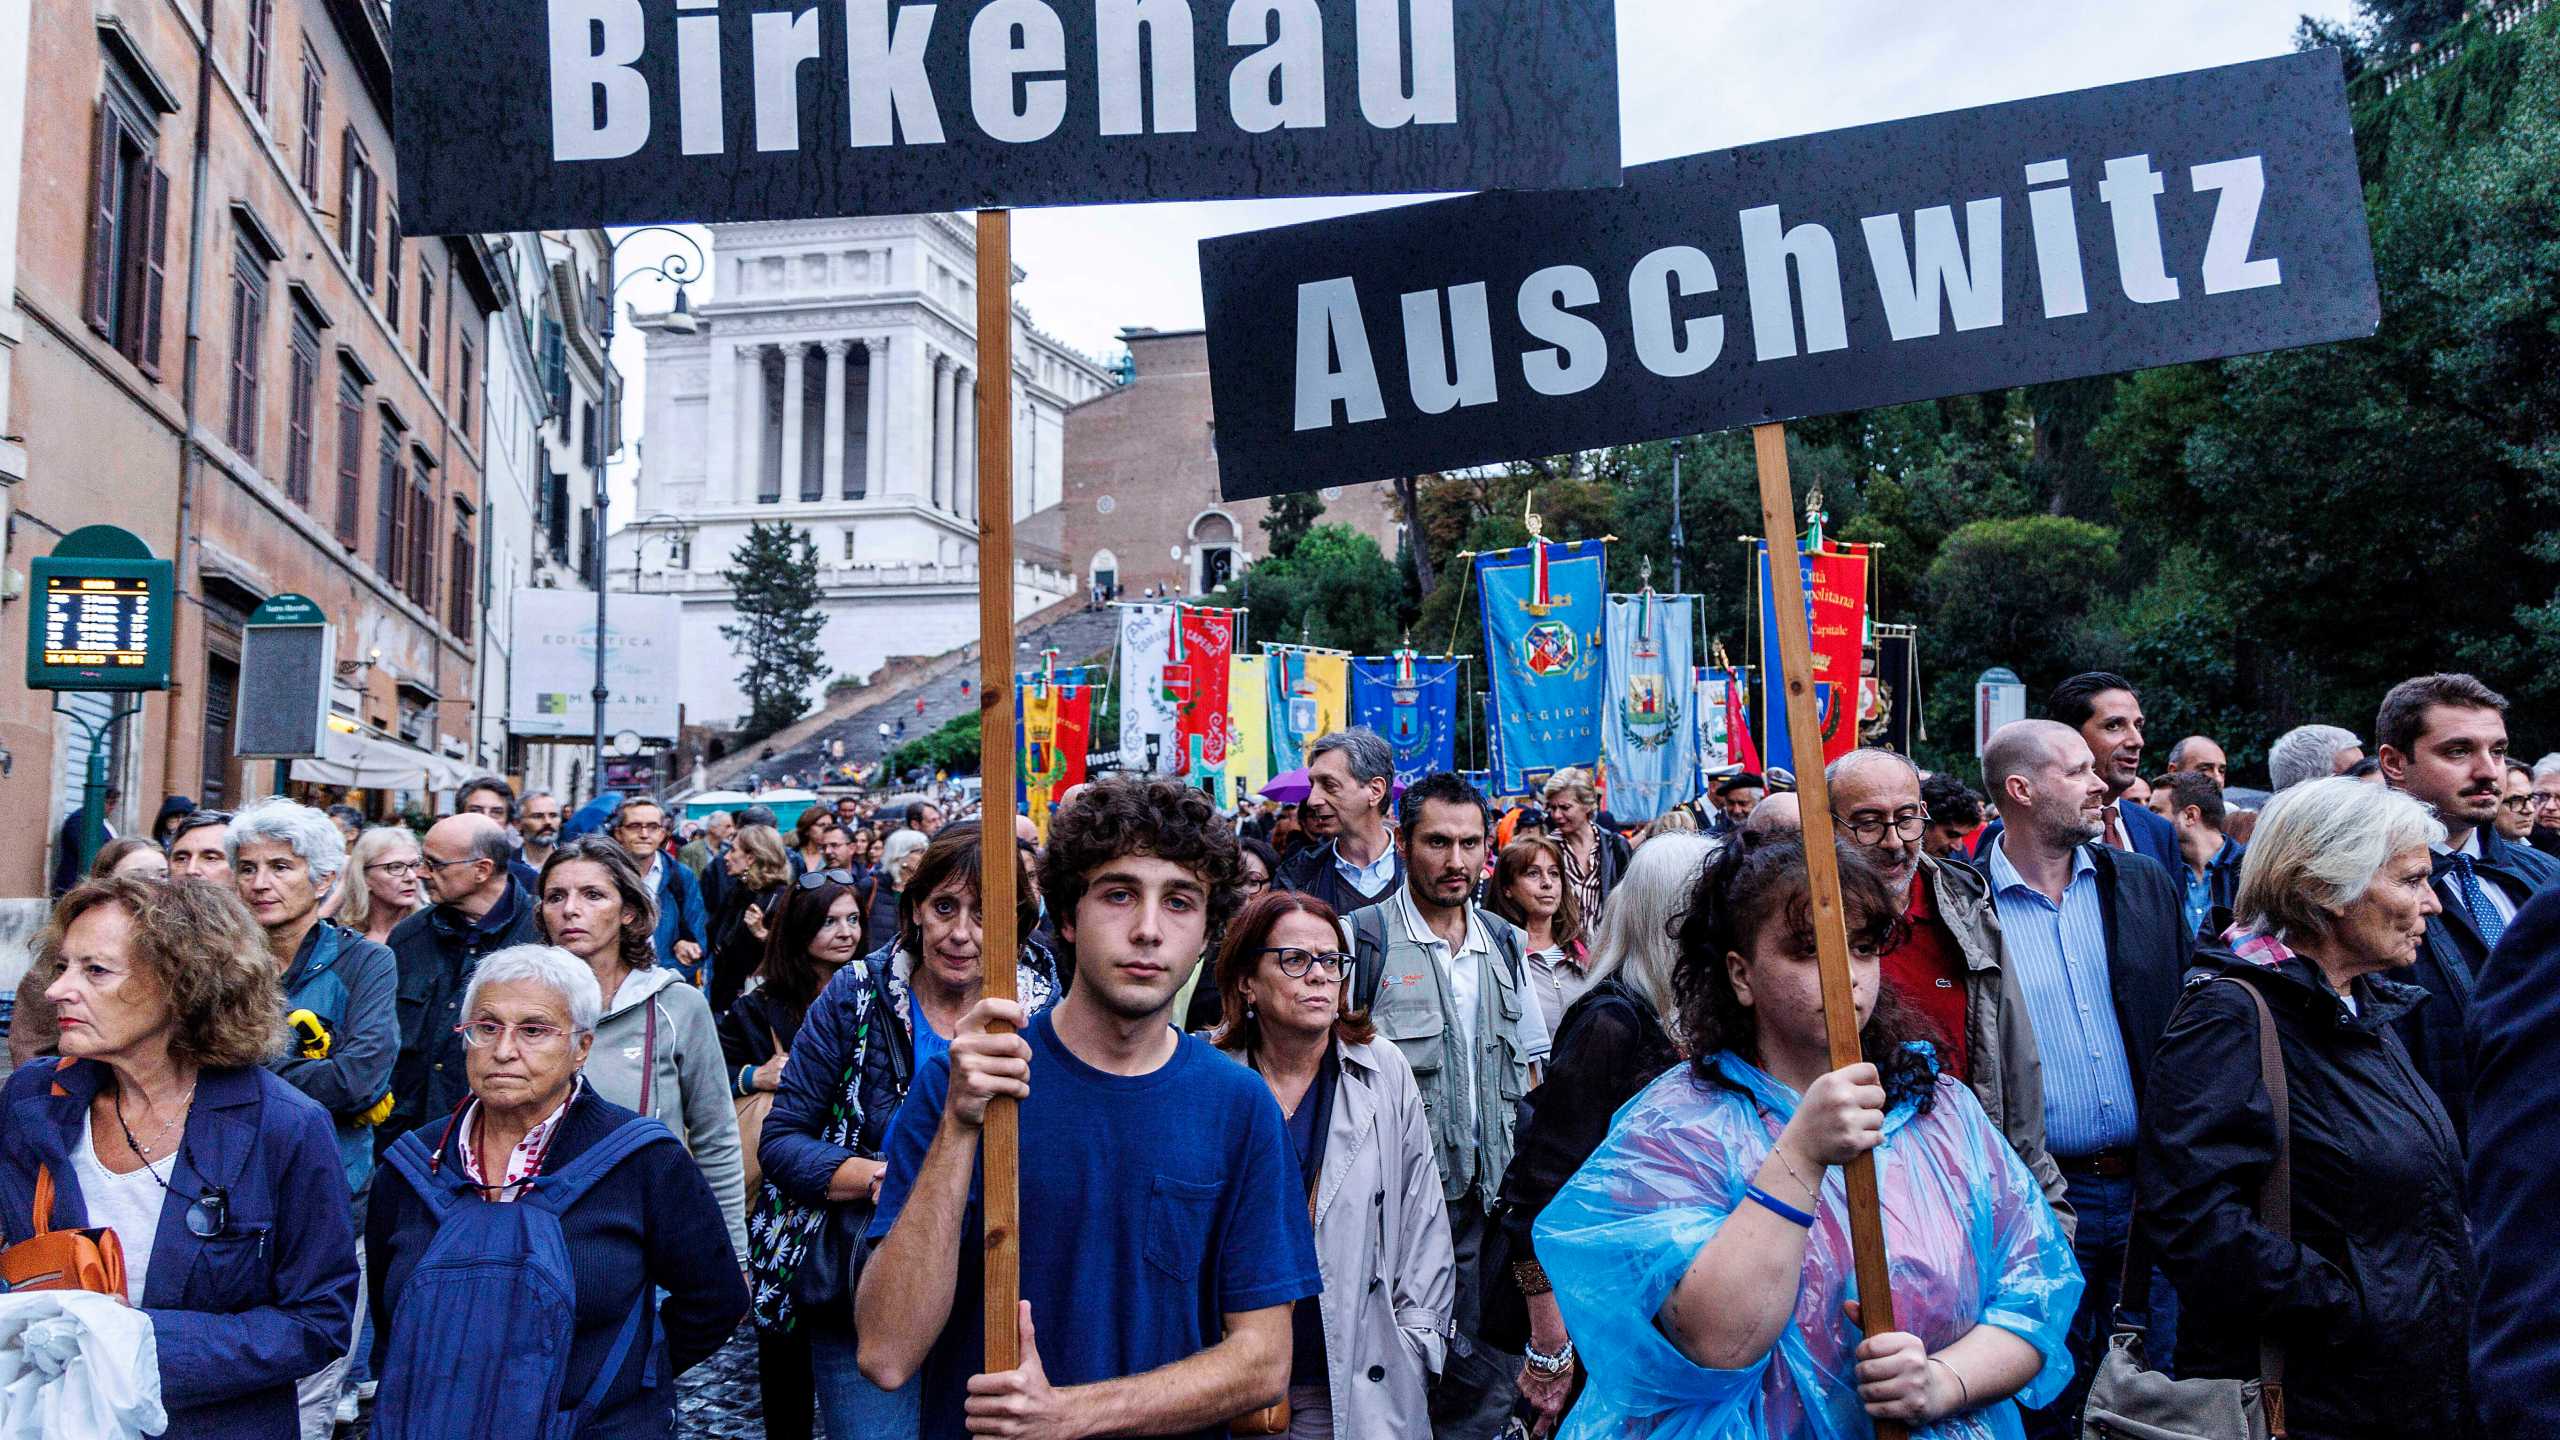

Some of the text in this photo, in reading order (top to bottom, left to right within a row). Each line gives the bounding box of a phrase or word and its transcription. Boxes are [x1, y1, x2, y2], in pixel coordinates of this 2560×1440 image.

[548, 0, 1458, 162] Birkenau
[1293, 154, 2282, 432] Auschwitz
[1803, 587, 1855, 609] opolitana
[1811, 623, 1849, 638] Capitale
[542, 634, 652, 647] EDILTICA
[1136, 628, 1169, 653] COMUN
[568, 694, 659, 705] MANI
[1529, 726, 1590, 742] LAZIO
